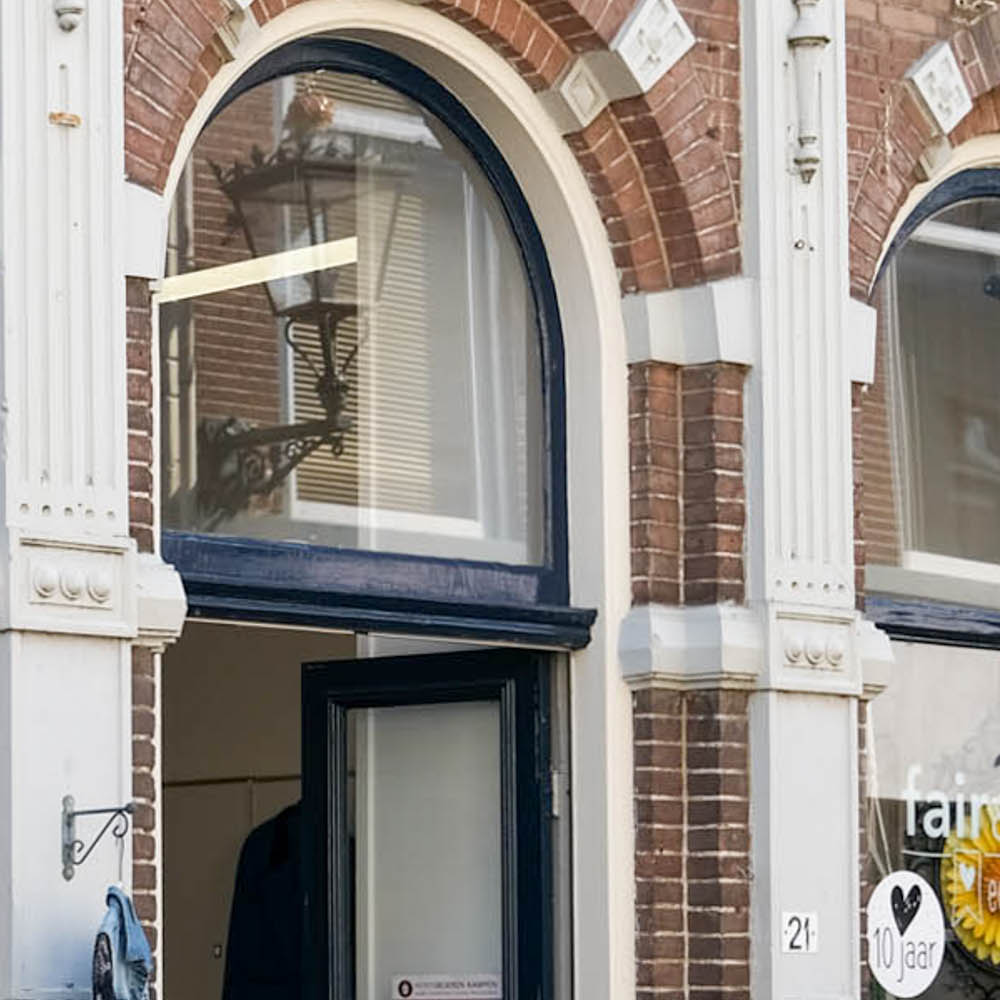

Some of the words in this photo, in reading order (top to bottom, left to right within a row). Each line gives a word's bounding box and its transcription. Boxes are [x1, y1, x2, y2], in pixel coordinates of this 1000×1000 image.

[787, 916, 810, 952] 21
[873, 927, 893, 969] 10
[897, 939, 936, 983] jaar
